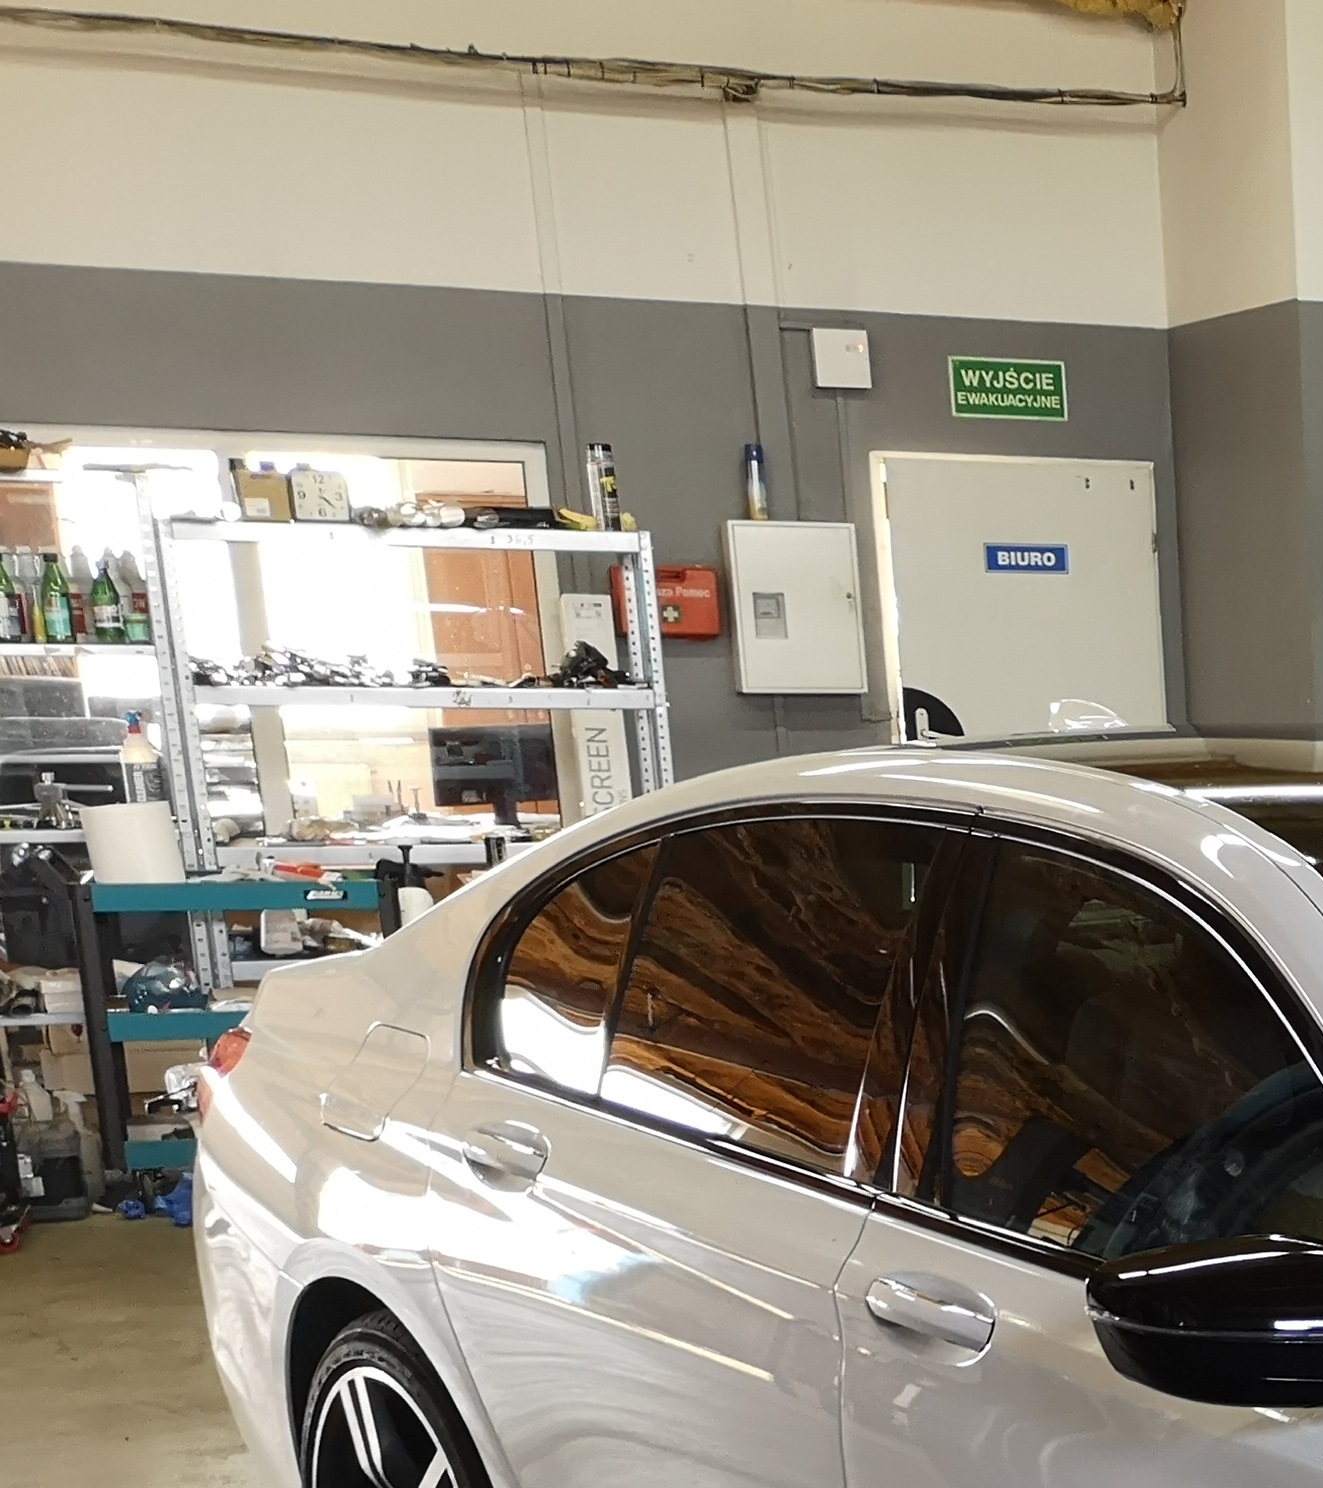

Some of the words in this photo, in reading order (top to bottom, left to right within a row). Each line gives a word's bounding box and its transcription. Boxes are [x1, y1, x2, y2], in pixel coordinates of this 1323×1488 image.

[960, 367, 1055, 390] WYJŚCIE
[957, 391, 1061, 409] EWAKUACYJNE
[312, 474, 325, 484] 12
[297, 490, 306, 500] 9
[335, 492, 343, 501] 3
[318, 508, 327, 518] 6
[997, 551, 1056, 566] BIURO
